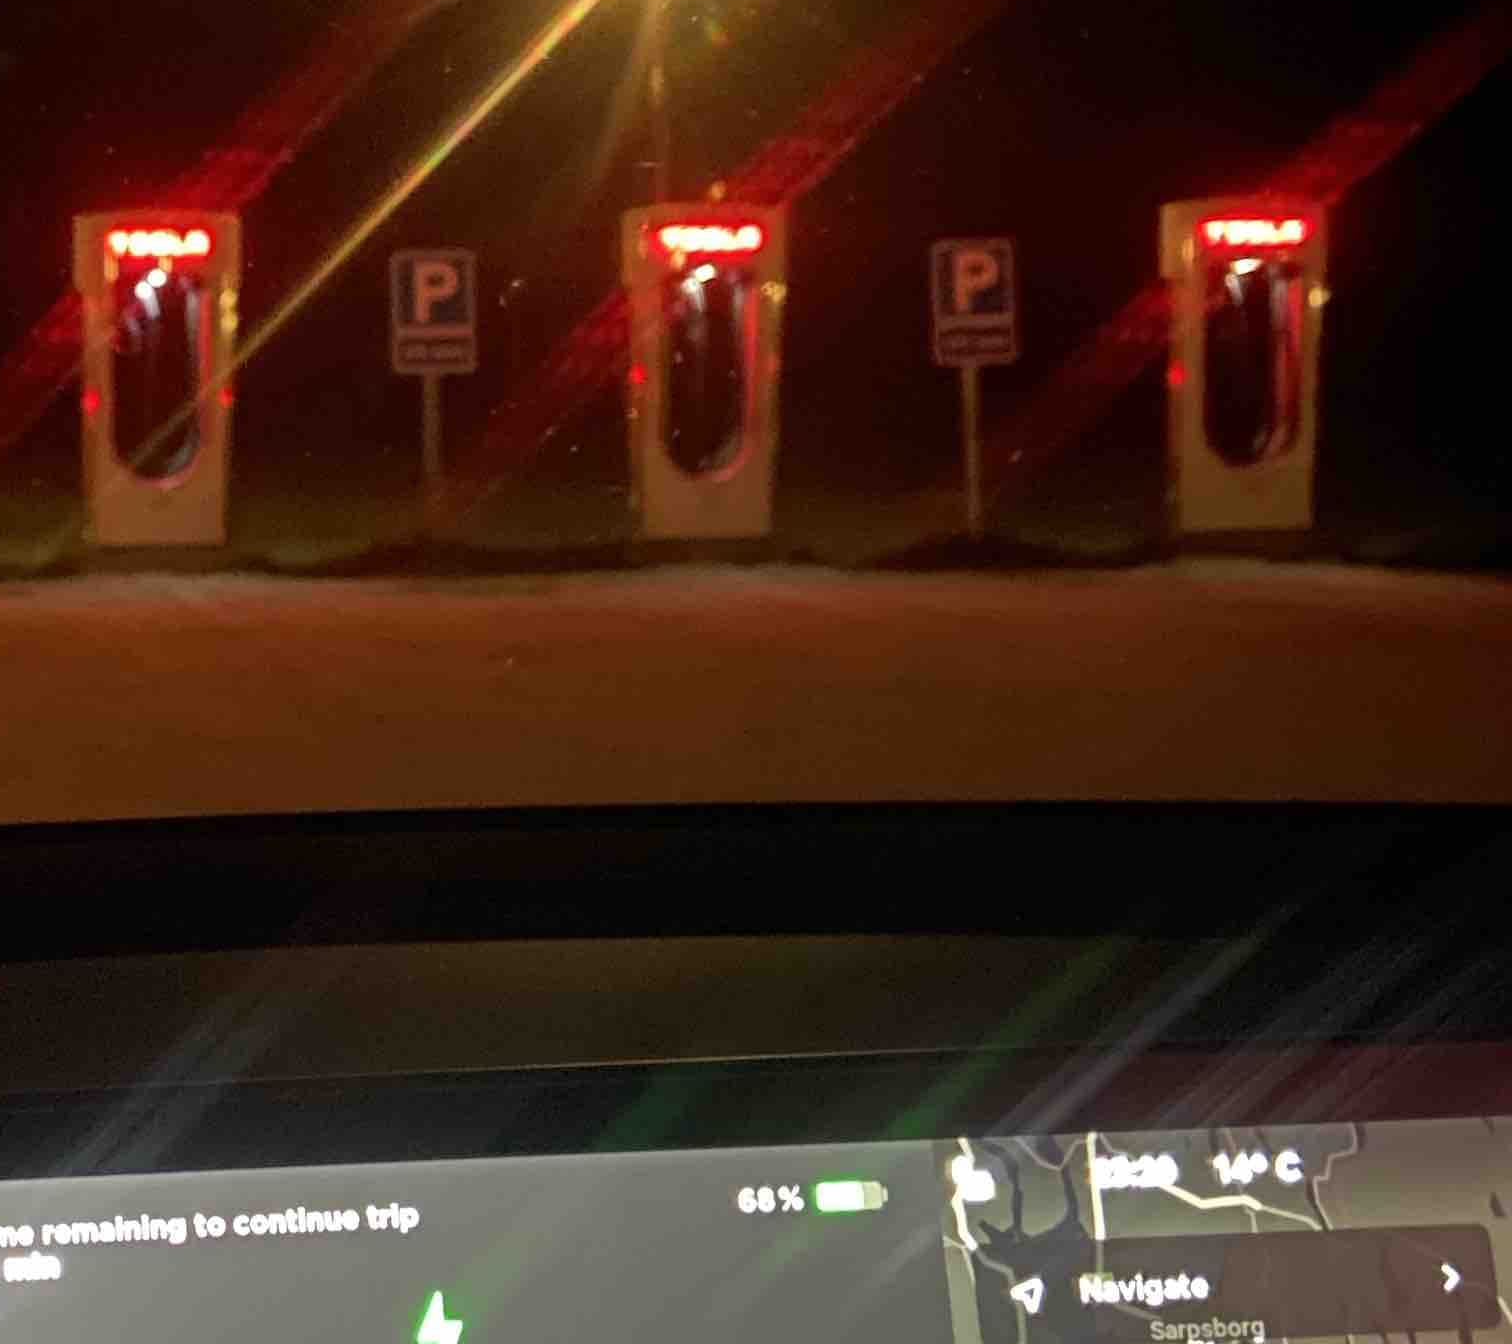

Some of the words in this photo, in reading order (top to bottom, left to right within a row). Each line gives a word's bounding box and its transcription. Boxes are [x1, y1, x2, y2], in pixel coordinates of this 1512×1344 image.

[41, 1213, 188, 1246] remaining
[193, 1212, 227, 1238] to
[232, 1206, 360, 1236] continue
[365, 1202, 420, 1234] trip
[1079, 1273, 1209, 1306] Navigate
